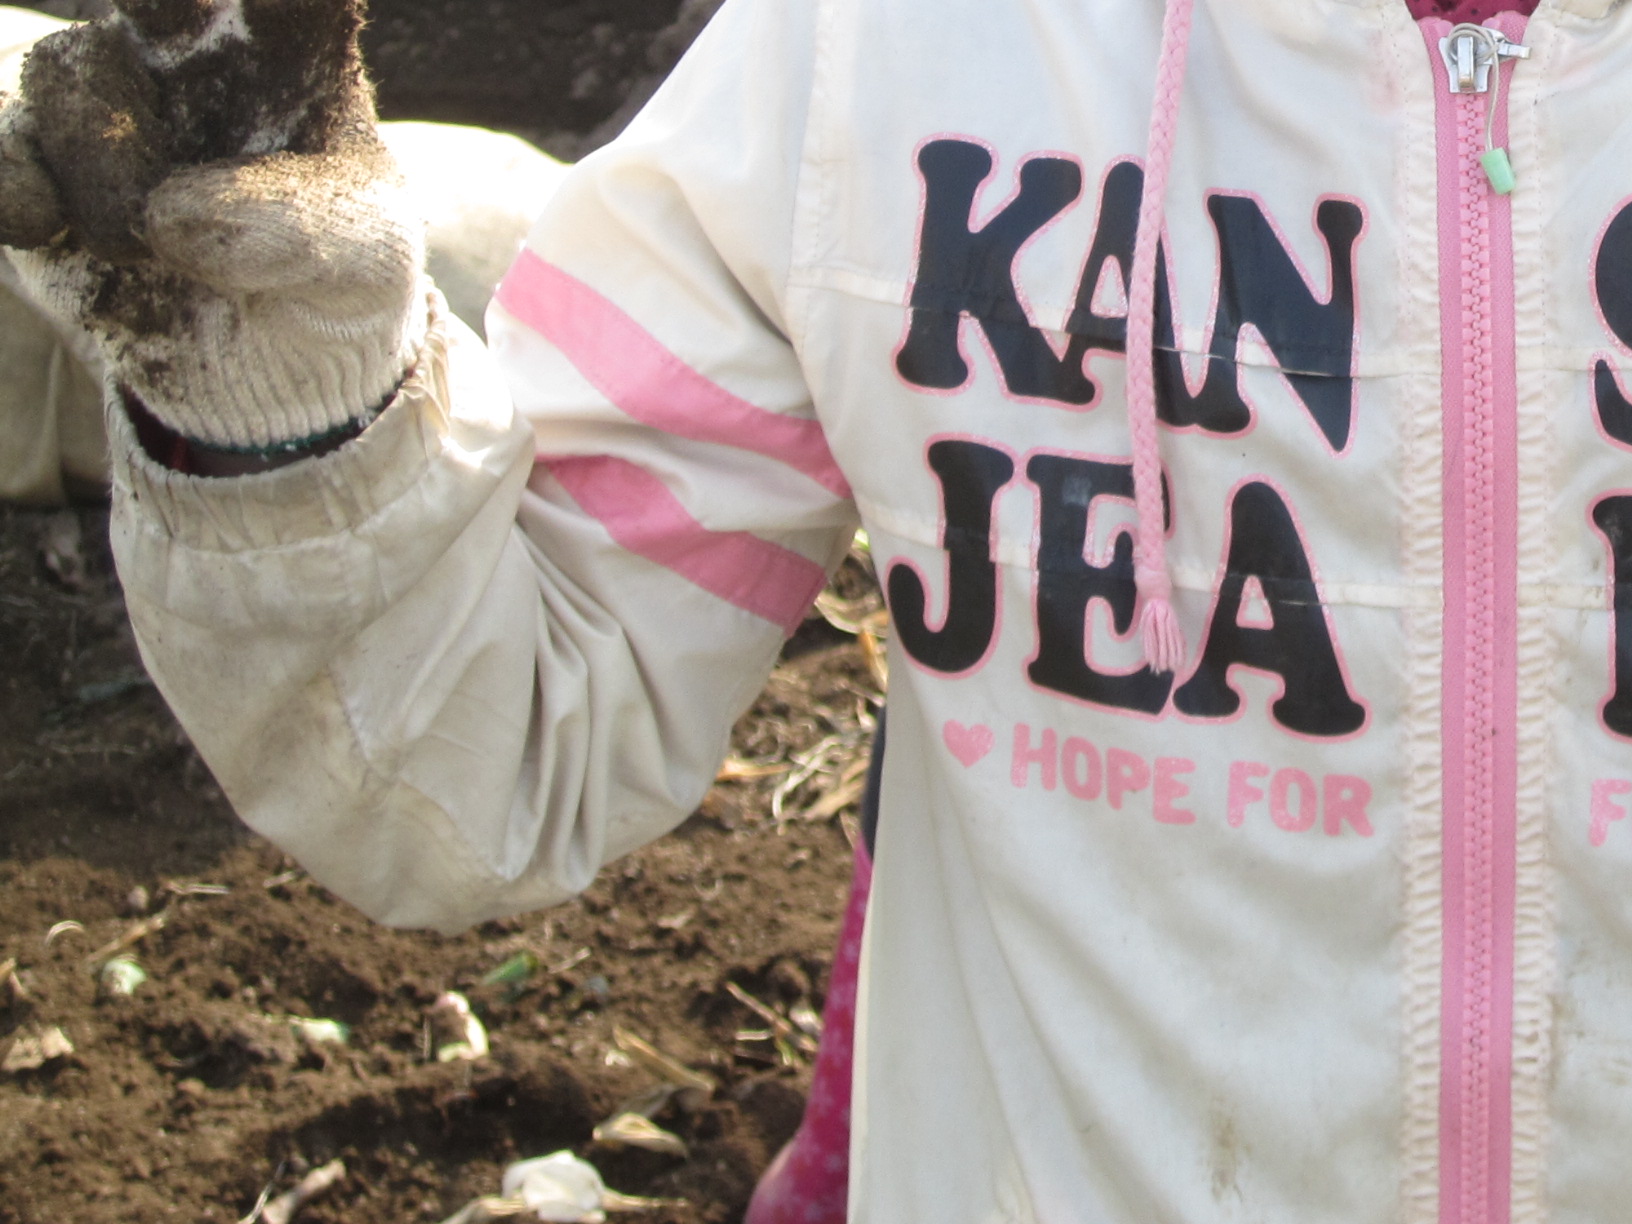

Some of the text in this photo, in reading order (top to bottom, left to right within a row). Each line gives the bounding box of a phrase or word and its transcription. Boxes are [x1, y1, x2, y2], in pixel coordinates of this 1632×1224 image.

[893, 133, 1370, 459] KAN
[883, 431, 1371, 740] JEA
[1009, 722, 1197, 826] HOPE
[1227, 761, 1375, 838] FOR
